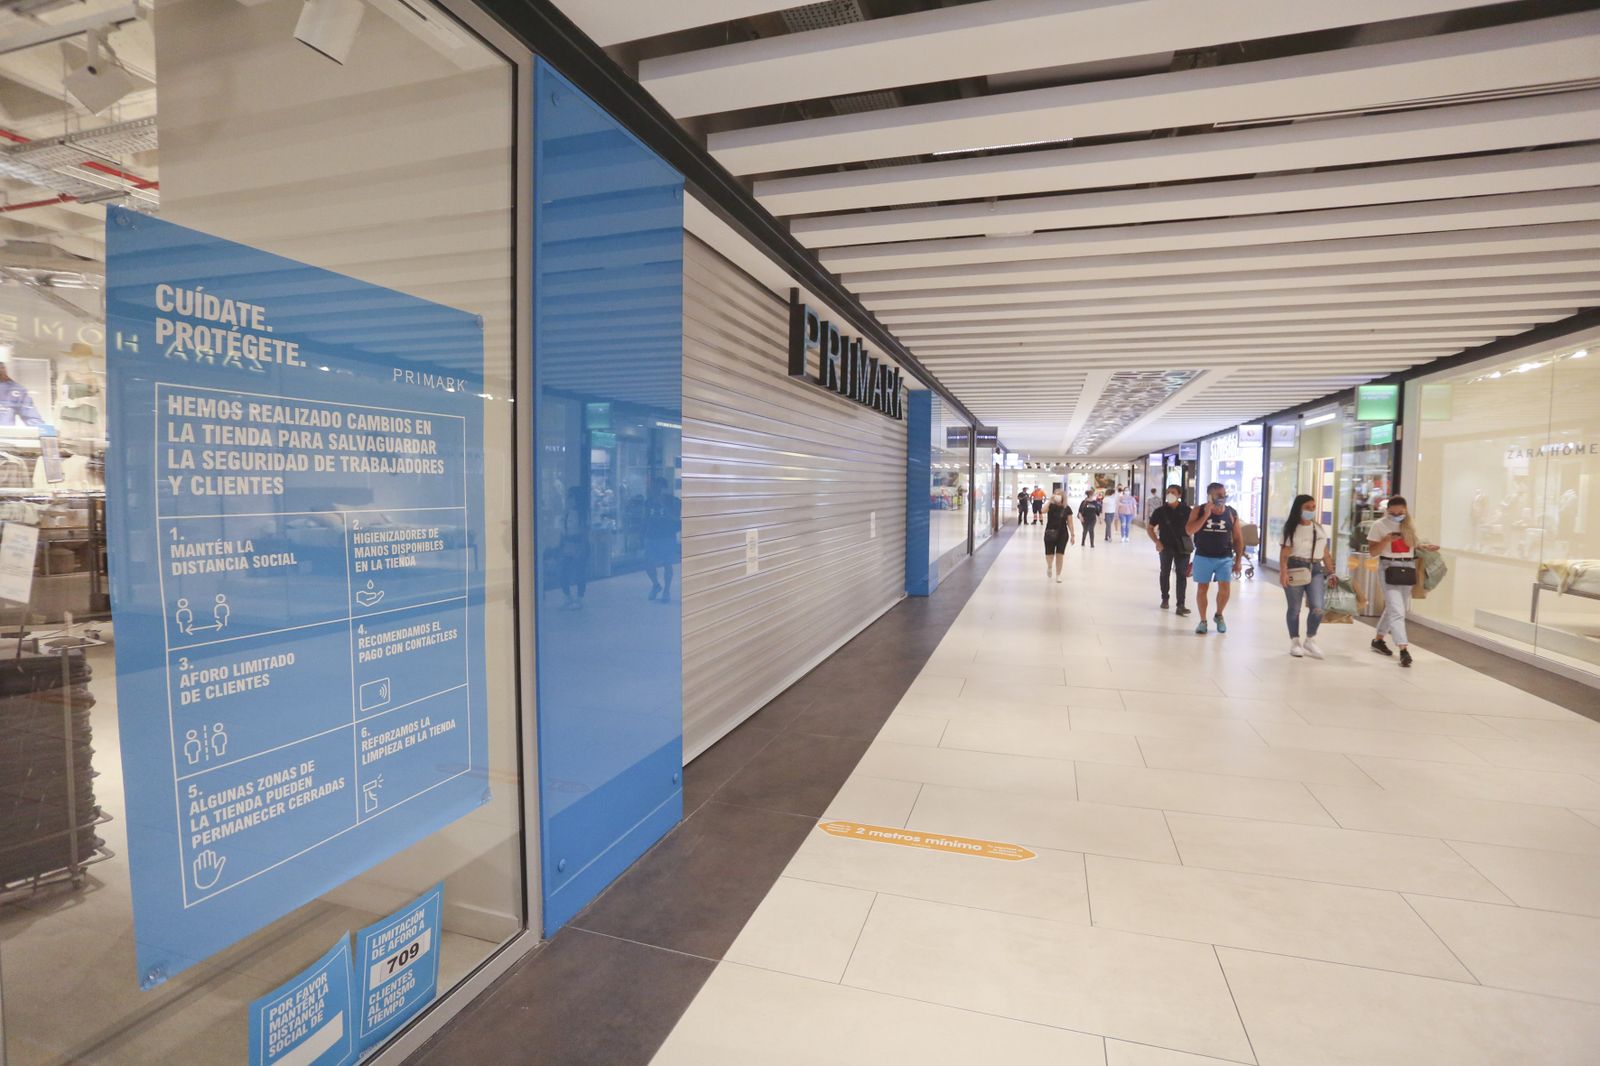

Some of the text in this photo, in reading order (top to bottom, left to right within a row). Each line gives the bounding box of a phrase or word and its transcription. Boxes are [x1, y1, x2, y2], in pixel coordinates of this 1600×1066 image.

[155, 283, 273, 332] CUÍDATE.
[155, 317, 307, 367] PROTÉGETE.
[788, 303, 904, 420] PRIMARK
[393, 367, 466, 392] PRIMARK
[168, 394, 432, 435] HEMOS REALIZADO CAMBIOS EN
[168, 422, 437, 455] LA TIENDA PARA SALVAGUARDAR
[1506, 443, 1599, 460] ZARA HOME
[168, 448, 444, 474] LA SEGURIDAD DE TRABAJADORES
[167, 475, 284, 496] Y CLIENTES
[169, 527, 185, 541] 1.
[352, 519, 362, 530] 2.
[353, 528, 439, 544] HIGIENIZADORES DE
[170, 538, 254, 558] MANTÉN LA
[171, 552, 297, 576] DISTANCIA SOCIAL
[354, 539, 444, 558] MANOS DISPONIBLES
[355, 556, 416, 573] EN LA TIENDA
[357, 624, 367, 636] 4.
[358, 620, 442, 649] RECOMENDAMOS EL
[359, 629, 458, 663] PAGO CON CONTACTLESS
[179, 657, 194, 671] 3.
[180, 652, 295, 688] AFORO LIMITADO
[181, 673, 270, 705] DE CLIENTES
[361, 727, 370, 738] 6.
[361, 716, 430, 752] REFORZAMOS LA
[362, 719, 456, 766] LIMPIEZA EN LA TIENDA
[188, 784, 203, 798] 5.
[189, 760, 315, 816] ALGUNAS ZONAS DE
[190, 775, 313, 832] LA TIENDA PUEDEN
[191, 777, 345, 849] PERMANECER CERRADAS
[855, 827, 865, 835] 2
[868, 831, 921, 843] metros
[371, 920, 425, 960] DE AFORO A
[372, 908, 425, 949] LIMITACIÓN
[387, 942, 419, 974] 709
[269, 972, 327, 1021] POR FAVOR
[317, 983, 329, 999] LA
[367, 978, 416, 1017] AL MISMO
[369, 969, 413, 1004] CLIENTES
[269, 998, 325, 1046] DISTANCIA
[368, 996, 405, 1027] TIEMPO
[269, 1010, 324, 1057] SOCIAL DE
